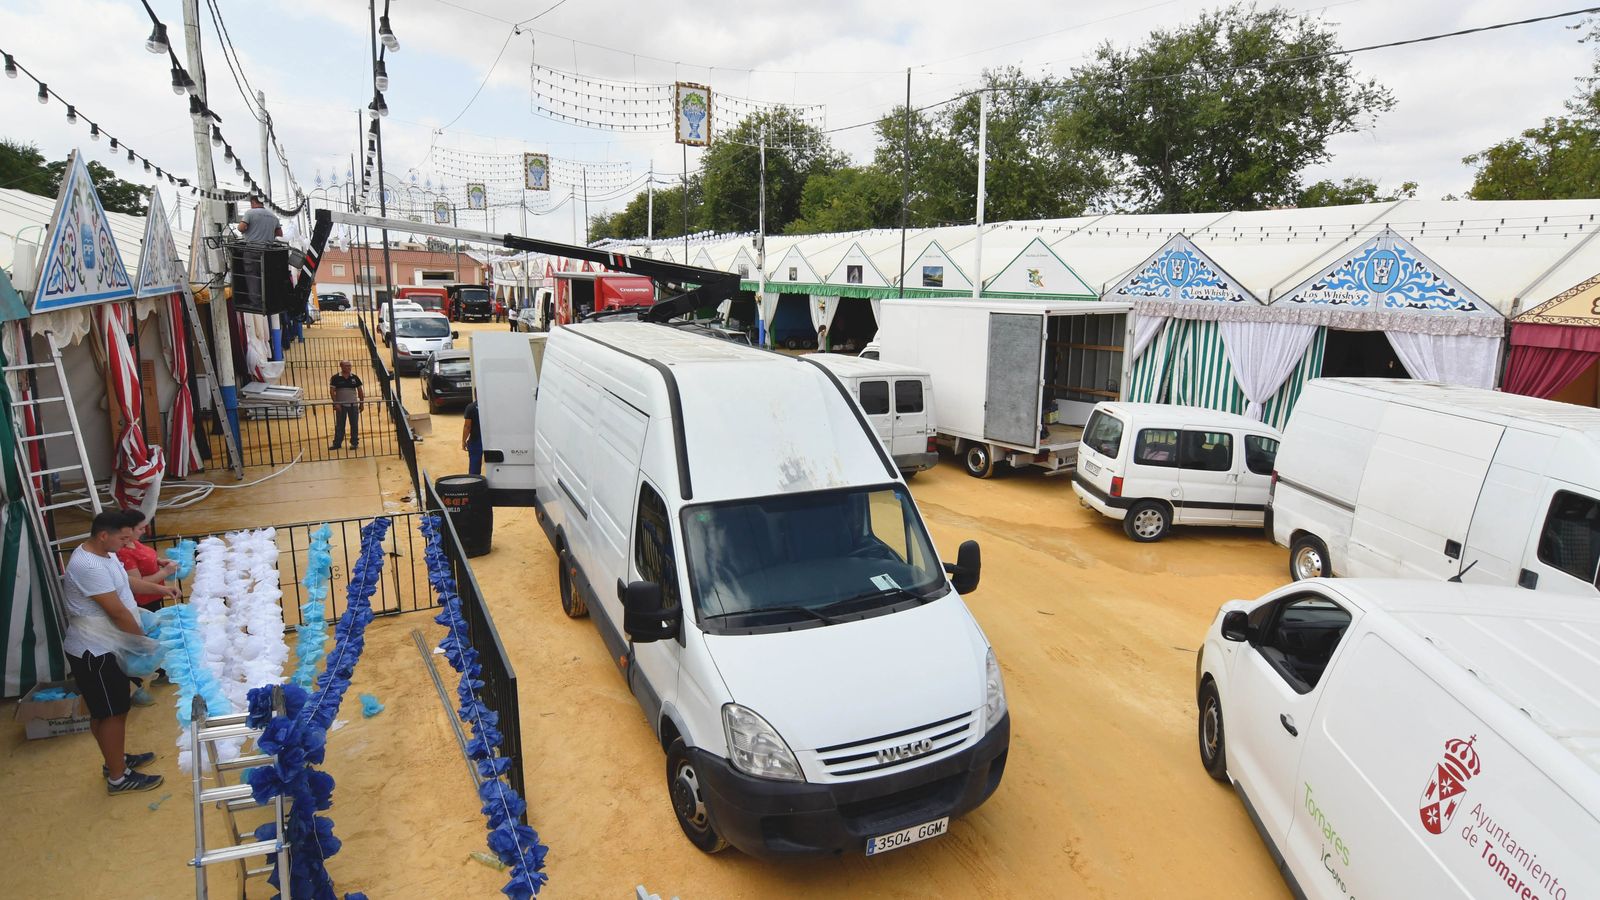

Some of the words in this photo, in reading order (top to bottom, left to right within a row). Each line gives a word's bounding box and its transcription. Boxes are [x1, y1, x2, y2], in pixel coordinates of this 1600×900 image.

[1190, 288, 1203, 296] Los
[1204, 288, 1235, 298] Whisky's
[1303, 290, 1318, 298] Los
[1323, 290, 1361, 300] Whisky's
[875, 738, 933, 763] IVECO
[878, 830, 911, 850] 3504
[918, 820, 943, 839] GGM
[1304, 781, 1350, 867] Tomares
[1461, 825, 1478, 848] de
[1470, 803, 1567, 900] Ayuntamiento
